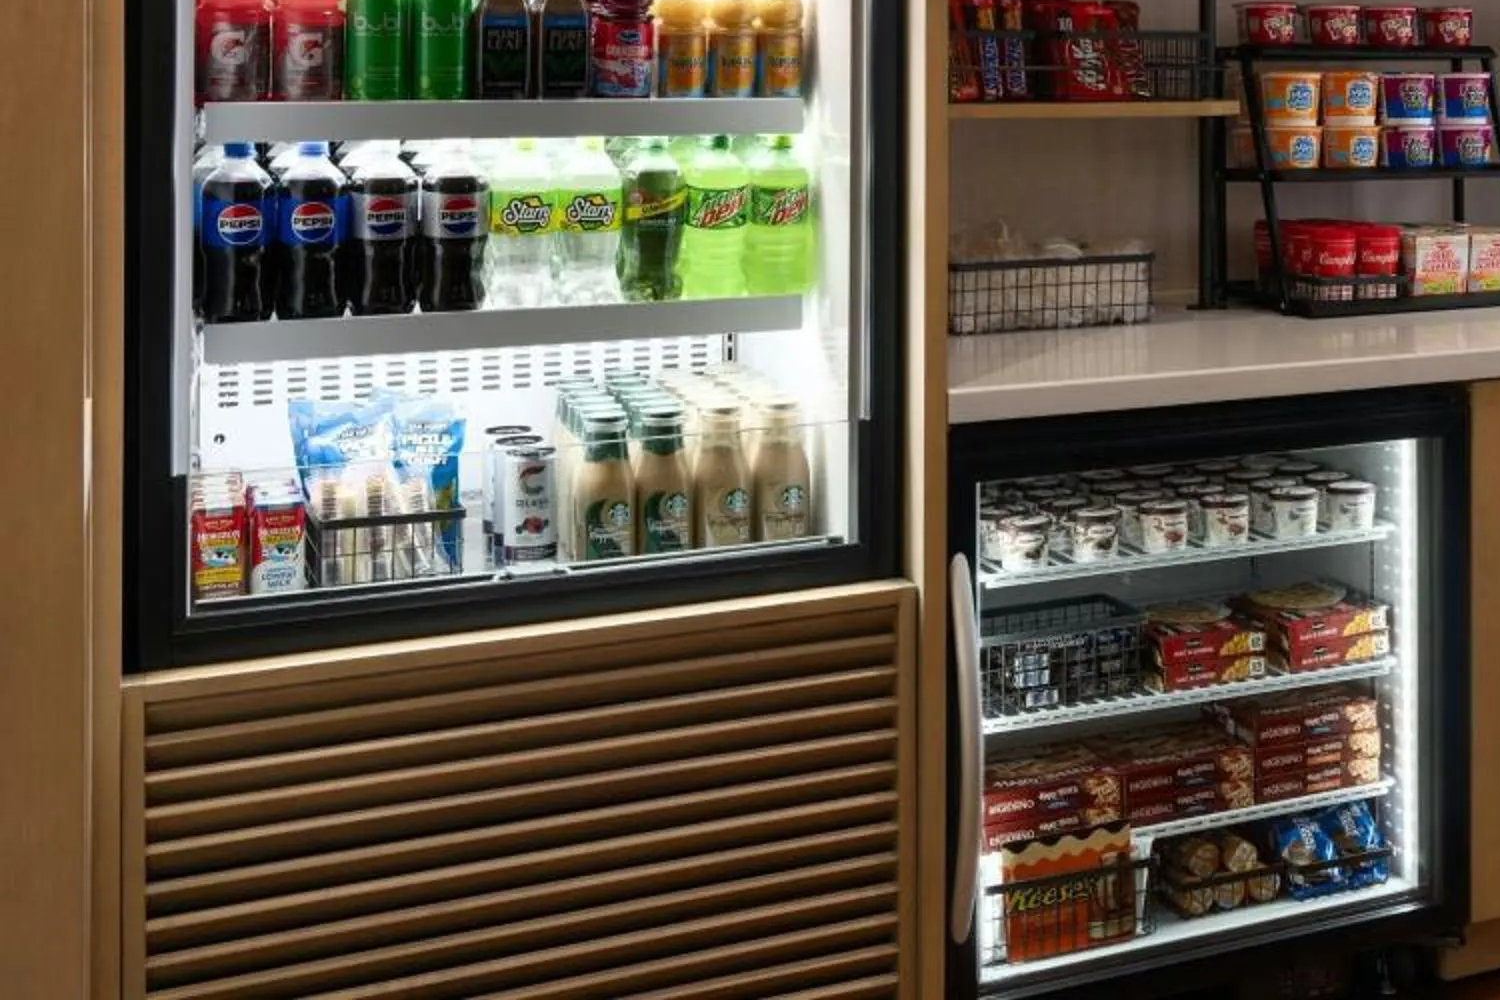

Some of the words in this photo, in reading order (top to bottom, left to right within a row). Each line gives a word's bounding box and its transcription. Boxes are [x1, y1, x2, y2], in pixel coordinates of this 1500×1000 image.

[293, 216, 333, 226] PEPSI
[367, 212, 405, 222] PEPSI
[219, 219, 260, 229] PEPSI
